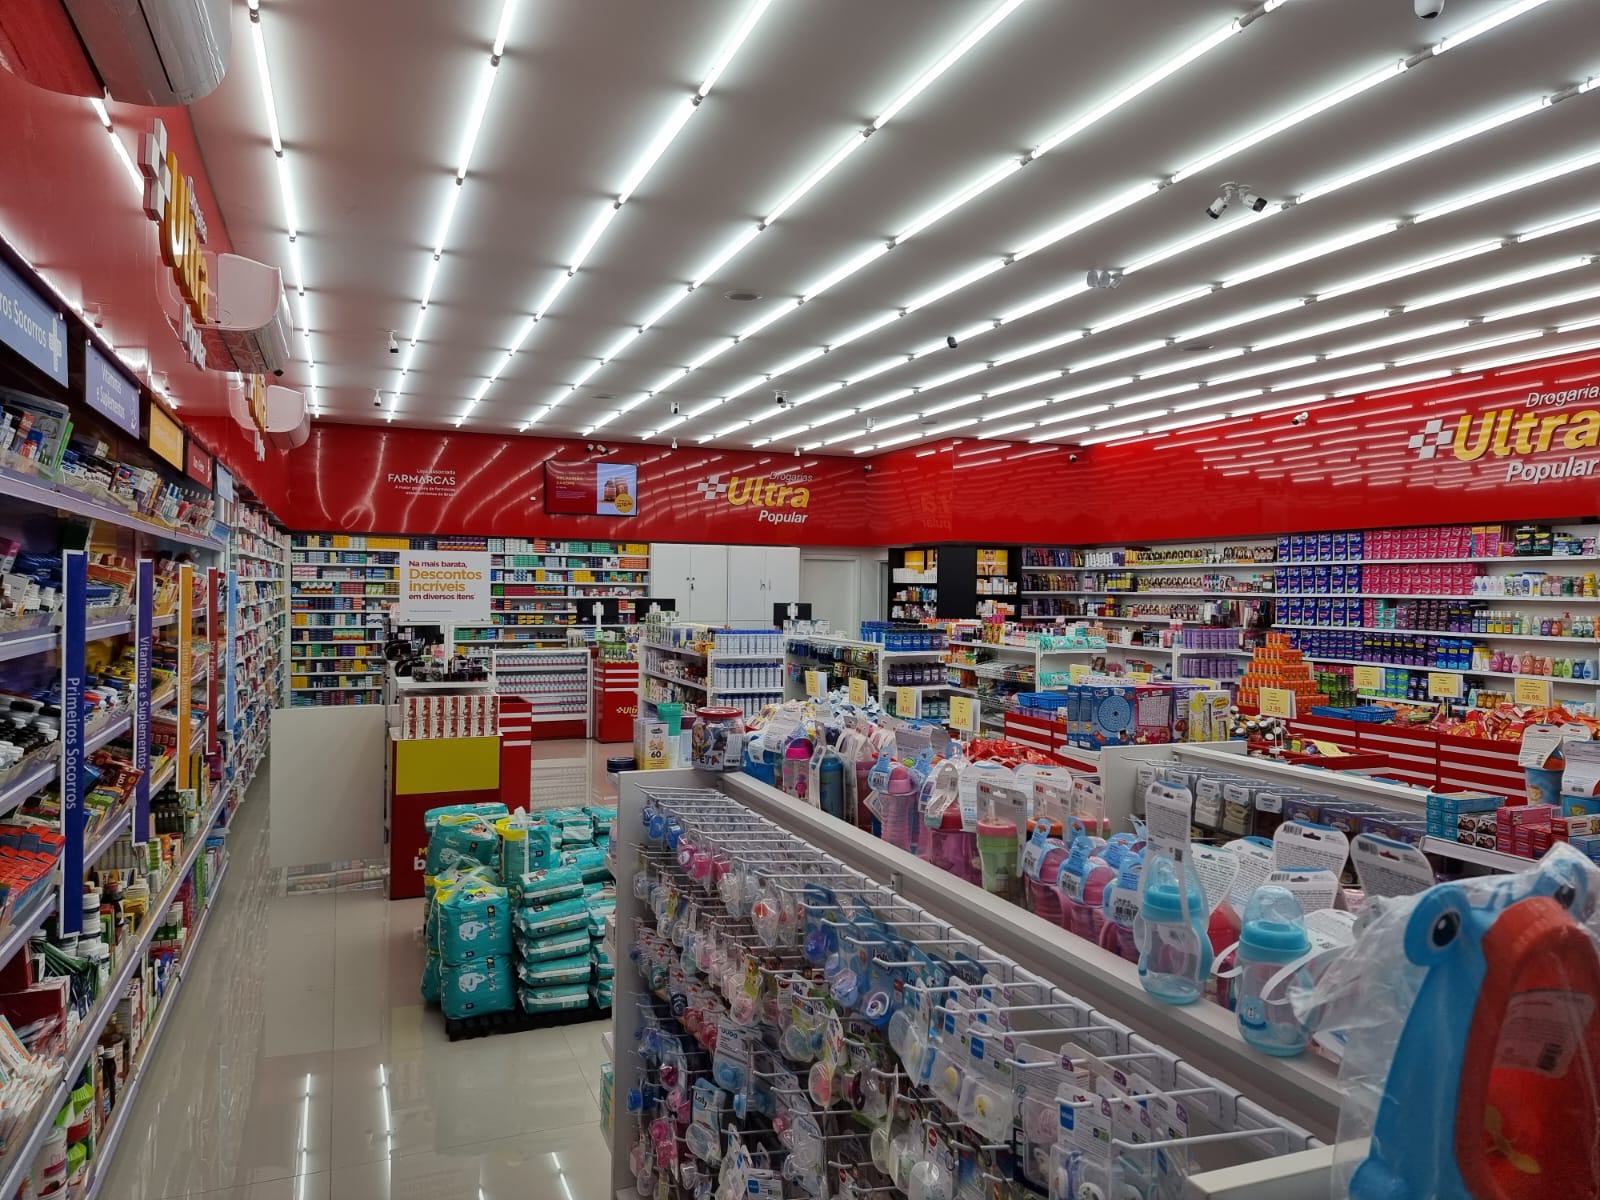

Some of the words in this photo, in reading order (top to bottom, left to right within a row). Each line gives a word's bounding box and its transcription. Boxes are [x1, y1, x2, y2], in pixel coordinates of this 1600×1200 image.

[14, 298, 47, 349] Socorros
[1453, 408, 1600, 461] Ultra
[387, 473, 456, 486] FARMARCAS
[769, 471, 813, 483] Drogarias
[1504, 455, 1599, 485] Popular
[727, 476, 811, 508] Ultra
[758, 509, 809, 525] Popular
[409, 568, 483, 580] Descontos
[421, 560, 440, 568] mais
[441, 560, 467, 569] barata,
[409, 580, 466, 592] incríveis
[138, 636, 150, 687] Vitaminas
[66, 677, 81, 745] Primeiros
[137, 700, 150, 769] Suplementos
[650, 750, 662, 759] 60
[66, 748, 80, 810] Socorros
